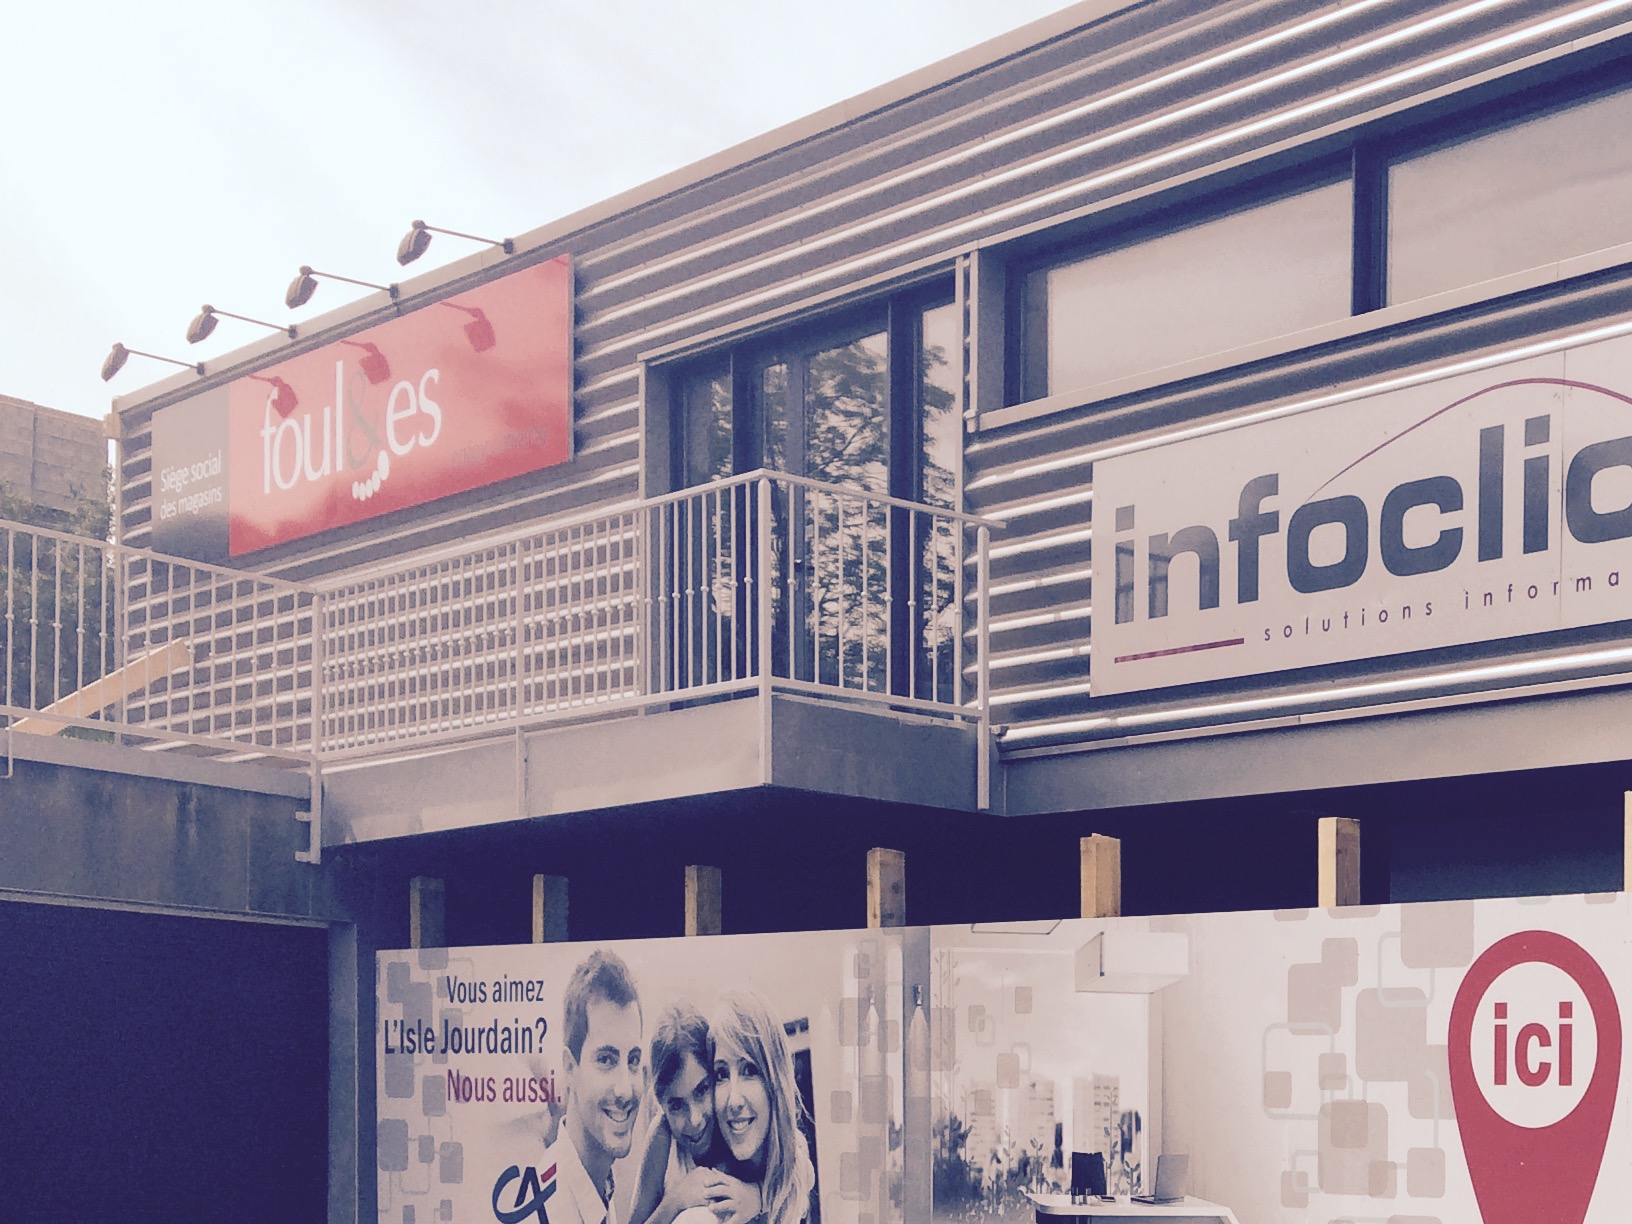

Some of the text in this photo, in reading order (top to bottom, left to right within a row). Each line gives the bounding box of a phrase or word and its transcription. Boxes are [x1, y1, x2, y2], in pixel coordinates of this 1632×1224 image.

[160, 449, 222, 493] Siège social
[160, 485, 222, 520] des magasins
[1264, 600, 1433, 642] solutions
[446, 974, 544, 1003] Vous aimez
[440, 1016, 548, 1054] Jourdain?
[1494, 1001, 1573, 1087] ici
[447, 1068, 561, 1103] Nous aussi.
